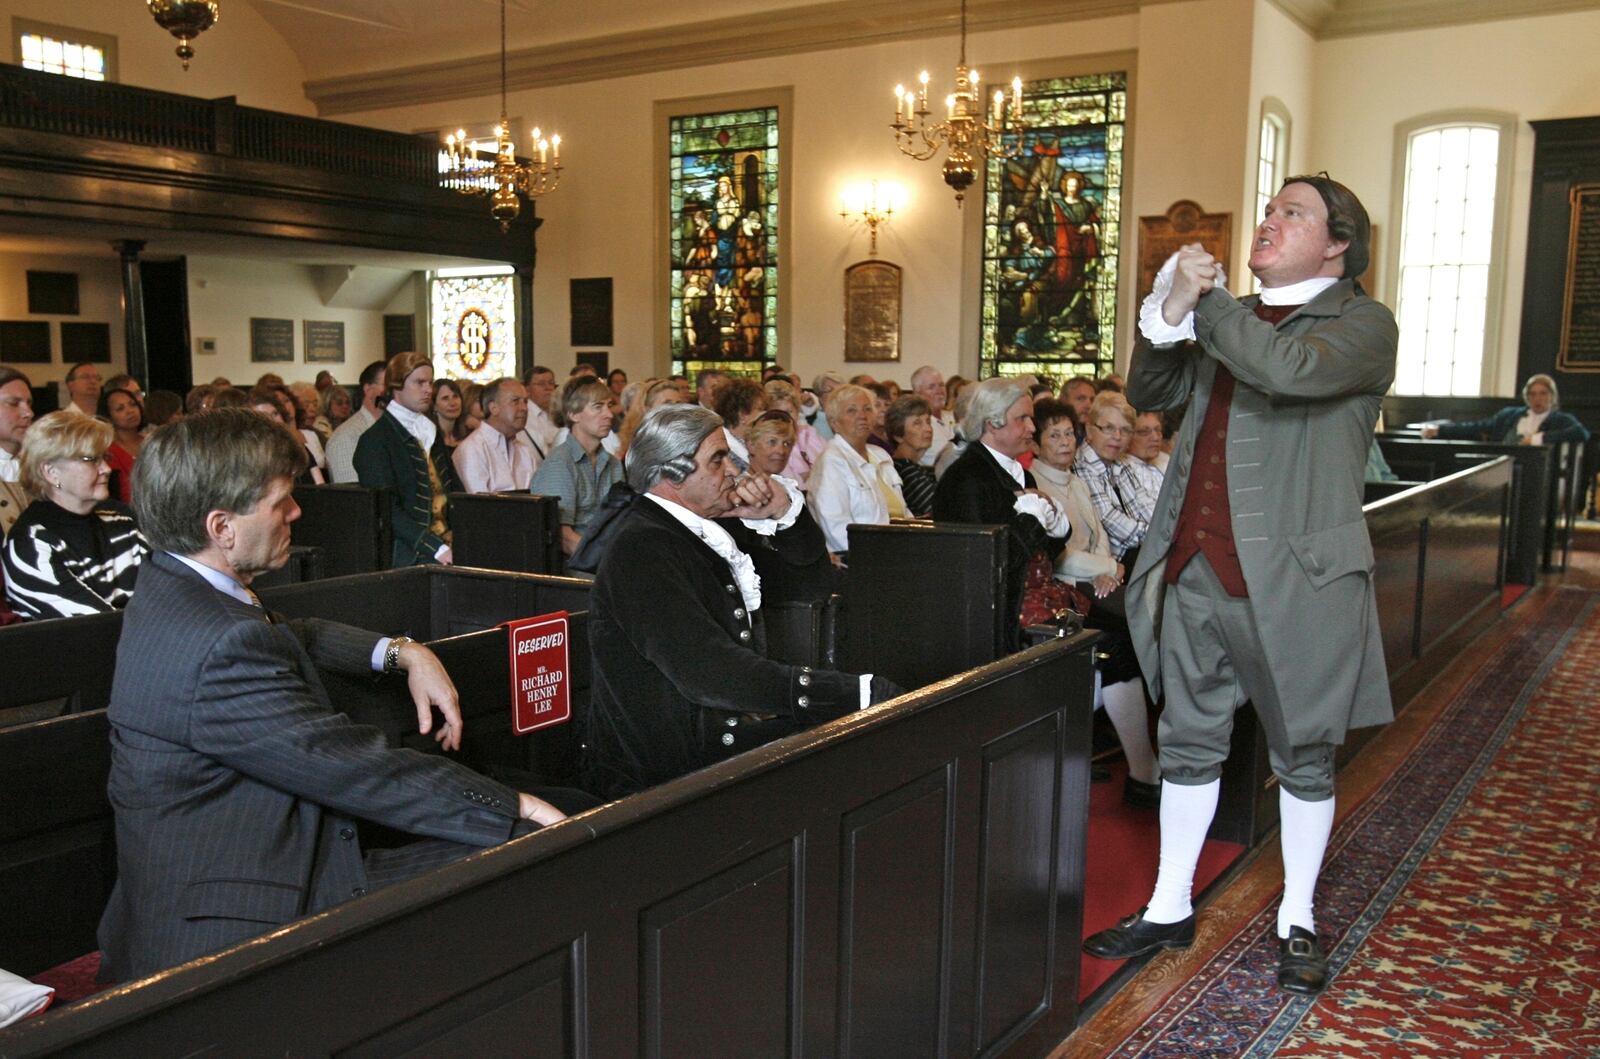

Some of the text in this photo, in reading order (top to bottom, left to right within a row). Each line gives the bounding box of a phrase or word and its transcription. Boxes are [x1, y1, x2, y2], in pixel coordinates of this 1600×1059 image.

[518, 633, 564, 655] RESERVED
[537, 666, 548, 674] MR.
[522, 671, 563, 691] RICHARD
[527, 685, 558, 702] HENRY
[535, 700, 552, 714] LEE
